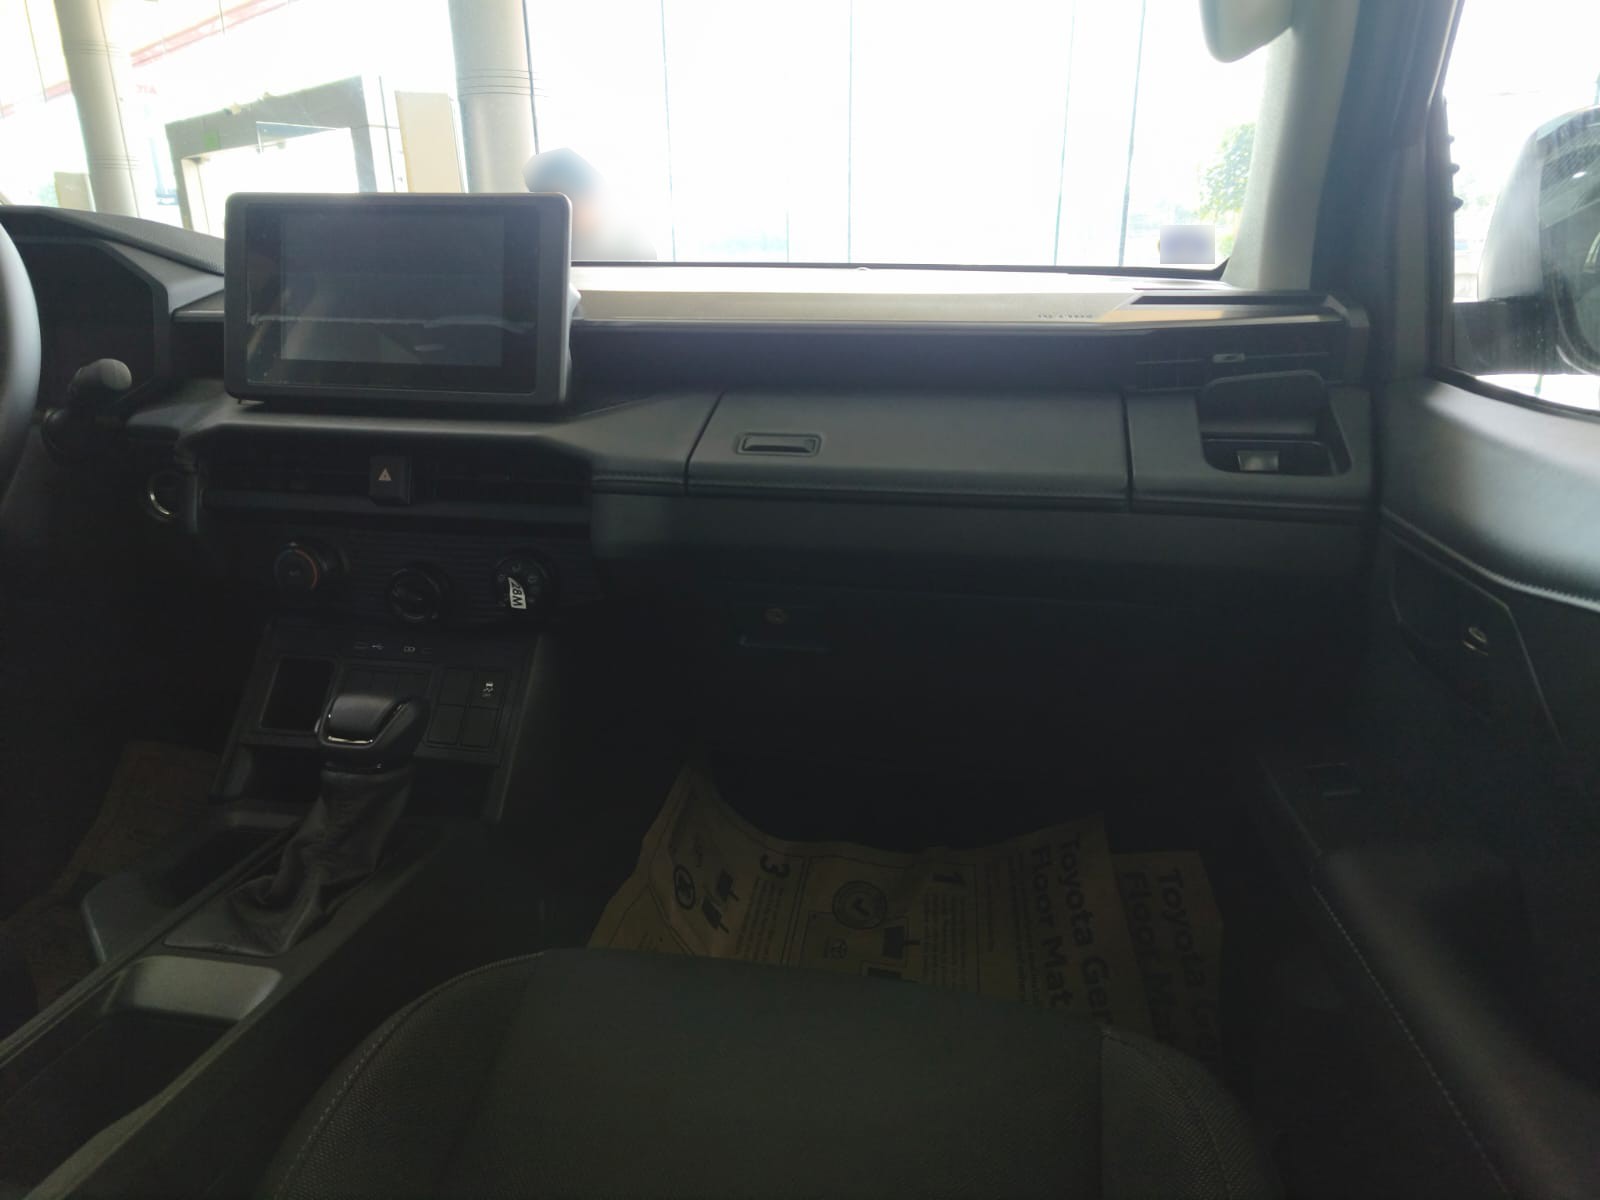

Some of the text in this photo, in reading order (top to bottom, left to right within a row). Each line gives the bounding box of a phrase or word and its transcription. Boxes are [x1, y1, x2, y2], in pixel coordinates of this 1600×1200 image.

[510, 582, 523, 606] 28M
[759, 854, 792, 880] 3
[933, 871, 968, 887] 1
[1057, 840, 1095, 947] Toyota
[1032, 844, 1073, 1009] Floor Mat
[1158, 867, 1206, 988] Toyota
